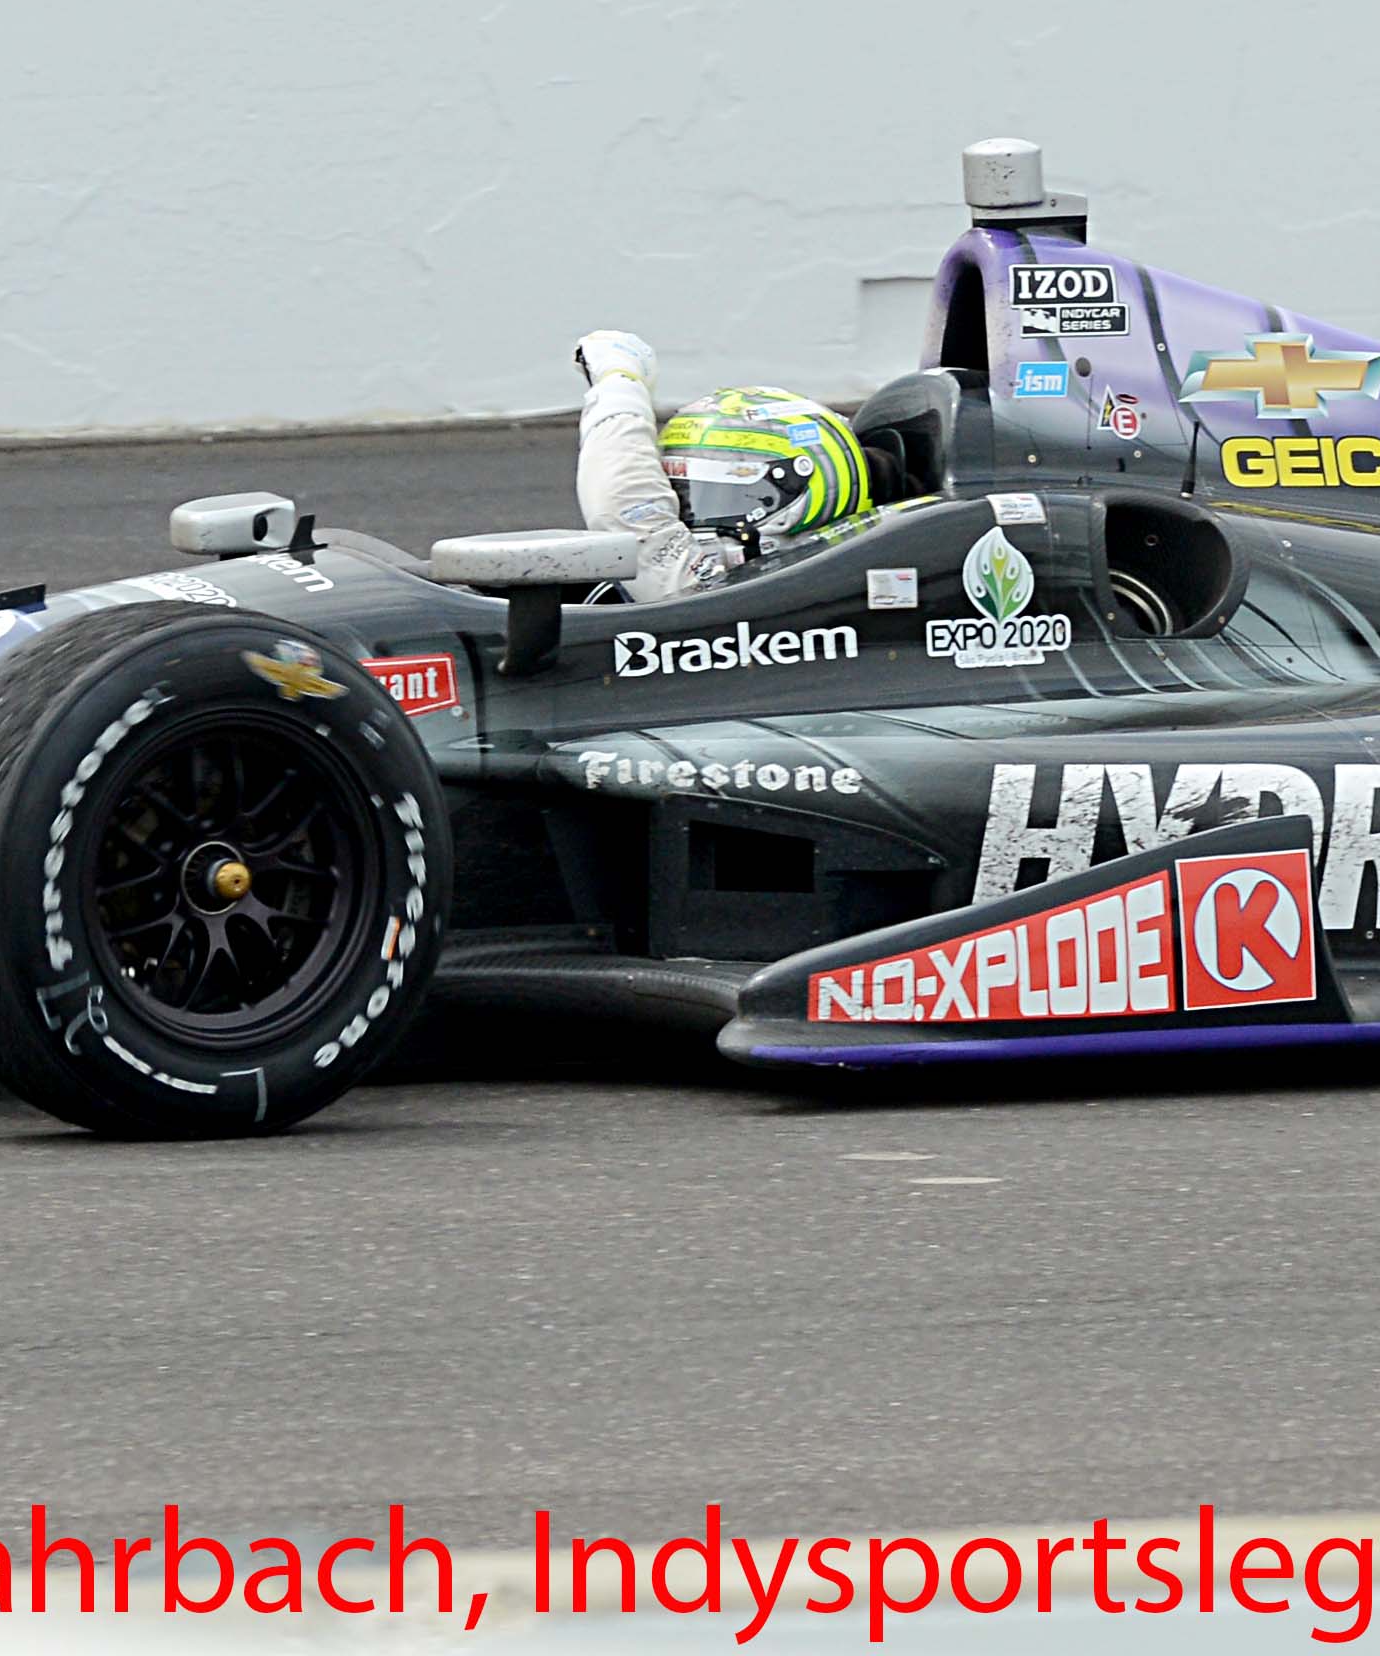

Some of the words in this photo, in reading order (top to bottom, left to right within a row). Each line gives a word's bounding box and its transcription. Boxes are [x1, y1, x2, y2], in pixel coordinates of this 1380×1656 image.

[1017, 272, 1109, 299] IZOD
[1061, 308, 1121, 319] INDYCAR
[1061, 320, 1112, 331] SERIES
[1024, 367, 1063, 393] ism
[615, 622, 858, 677] Braskem
[931, 622, 997, 651] EXPO
[1003, 619, 1066, 648] 2020
[577, 751, 863, 794] Firestone
[44, 698, 157, 971] Firestone
[315, 793, 426, 1069] Firestone
[818, 880, 1169, 1021] N.O.-XPLODE
